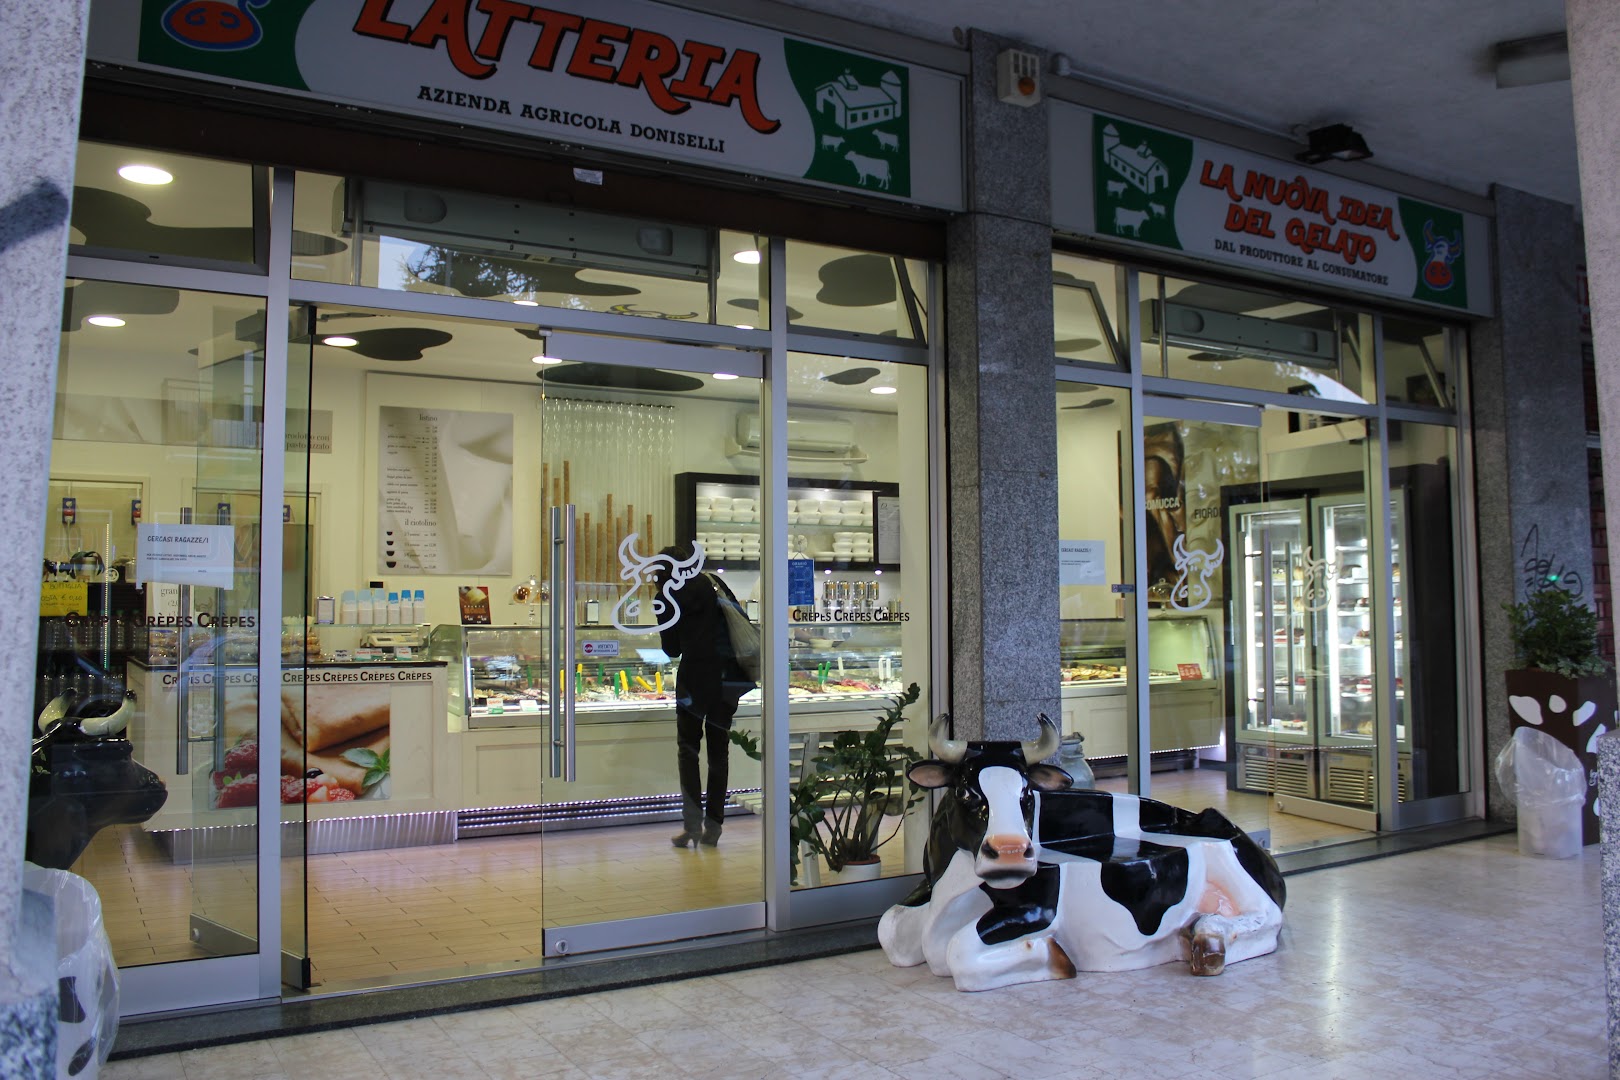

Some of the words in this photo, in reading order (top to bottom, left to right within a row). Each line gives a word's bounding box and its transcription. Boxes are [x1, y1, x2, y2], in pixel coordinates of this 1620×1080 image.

[353, 0, 781, 135] LATTERIA
[417, 85, 511, 115] AZIENDA
[519, 104, 622, 135] AGRICOLA
[630, 123, 725, 153] DONISELLI
[1200, 160, 1242, 202] LA
[1243, 170, 1336, 225] NUOVA
[1337, 195, 1400, 241] IDEA
[1224, 203, 1275, 239] DEL
[1285, 217, 1377, 265] GELATO
[1215, 239, 1236, 253] DAL
[1239, 245, 1303, 267] PRODUTTORE
[1307, 259, 1320, 271] AL
[1322, 263, 1389, 286] CONSUMATORE
[419, 413, 438, 421] listino
[1146, 497, 1180, 510] OMUCCA
[197, 612, 255, 628] CRÈPES
[834, 609, 872, 622] CRÈPES
[323, 671, 358, 682] CRÈPES
[360, 671, 395, 681] CRÈPES
[398, 671, 432, 681] CRÈPES
